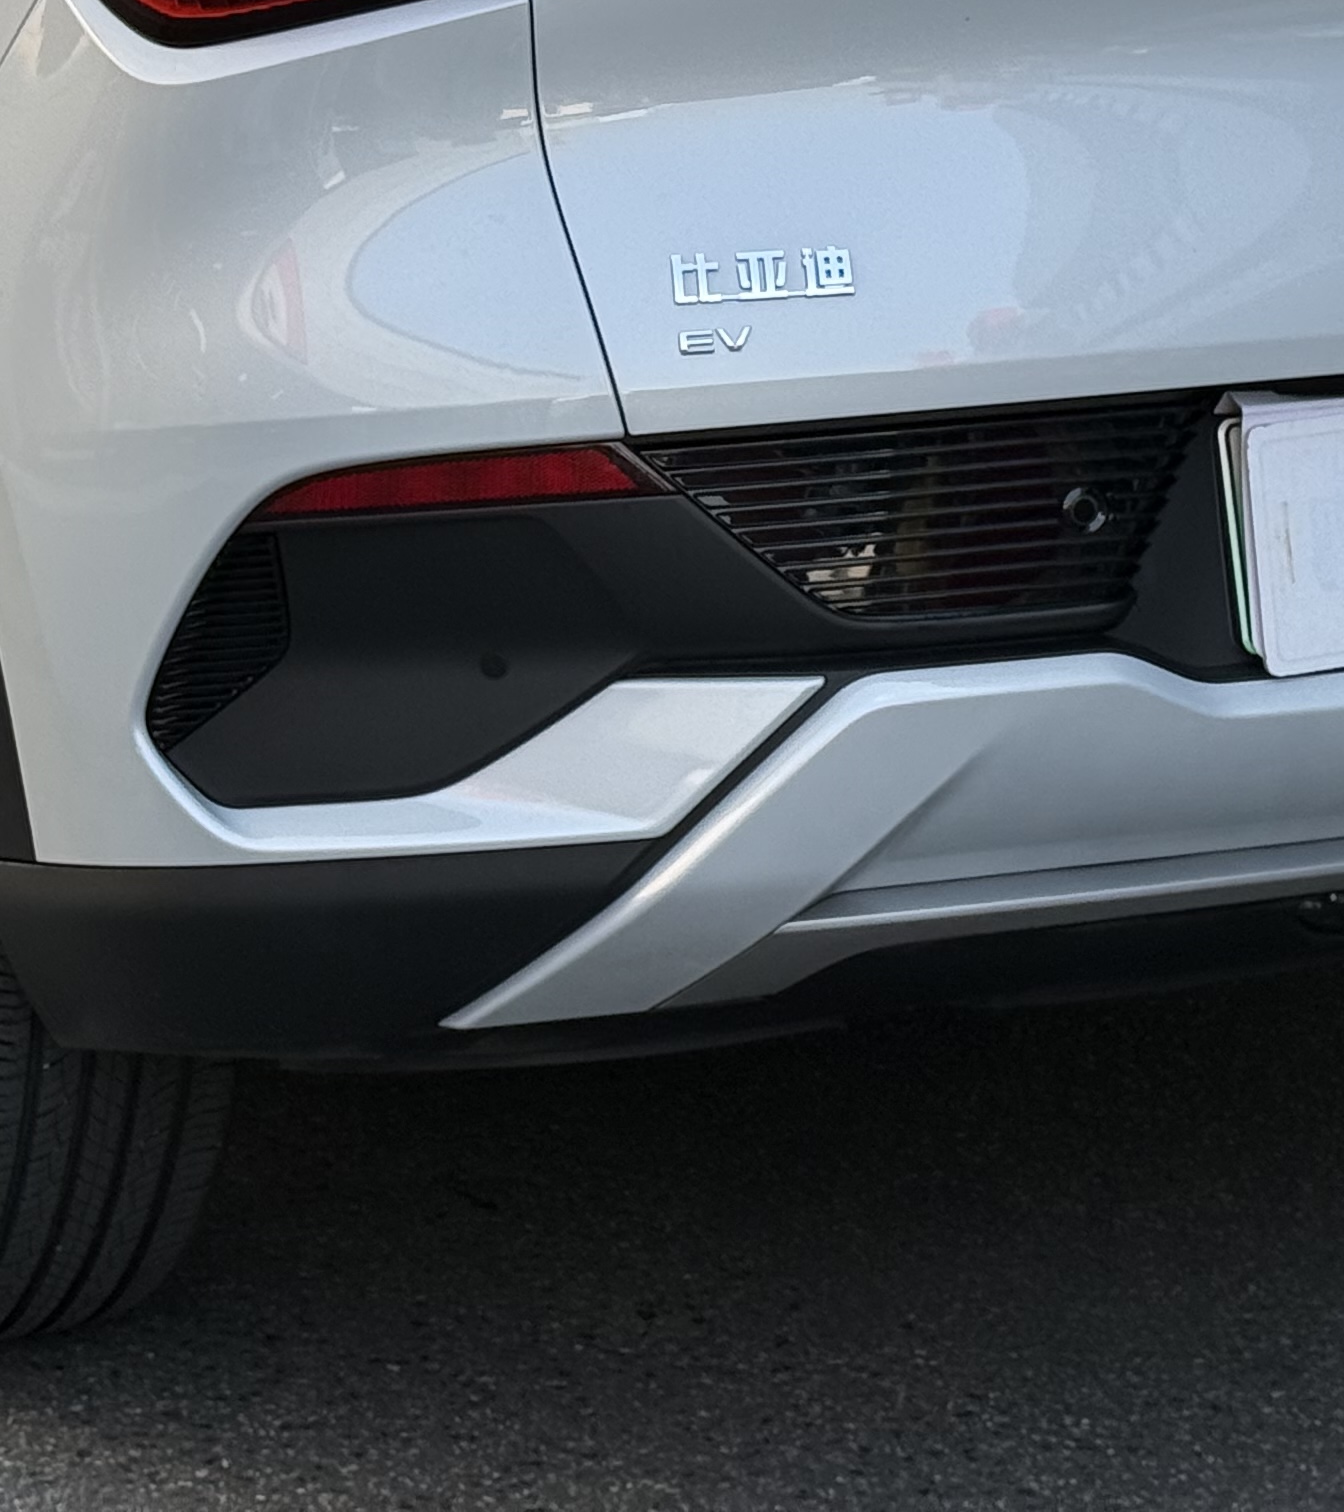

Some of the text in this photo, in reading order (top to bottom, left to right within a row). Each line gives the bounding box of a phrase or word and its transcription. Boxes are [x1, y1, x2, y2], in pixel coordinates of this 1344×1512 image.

[670, 245, 855, 305] 比亚迪
[678, 326, 752, 356] EV
